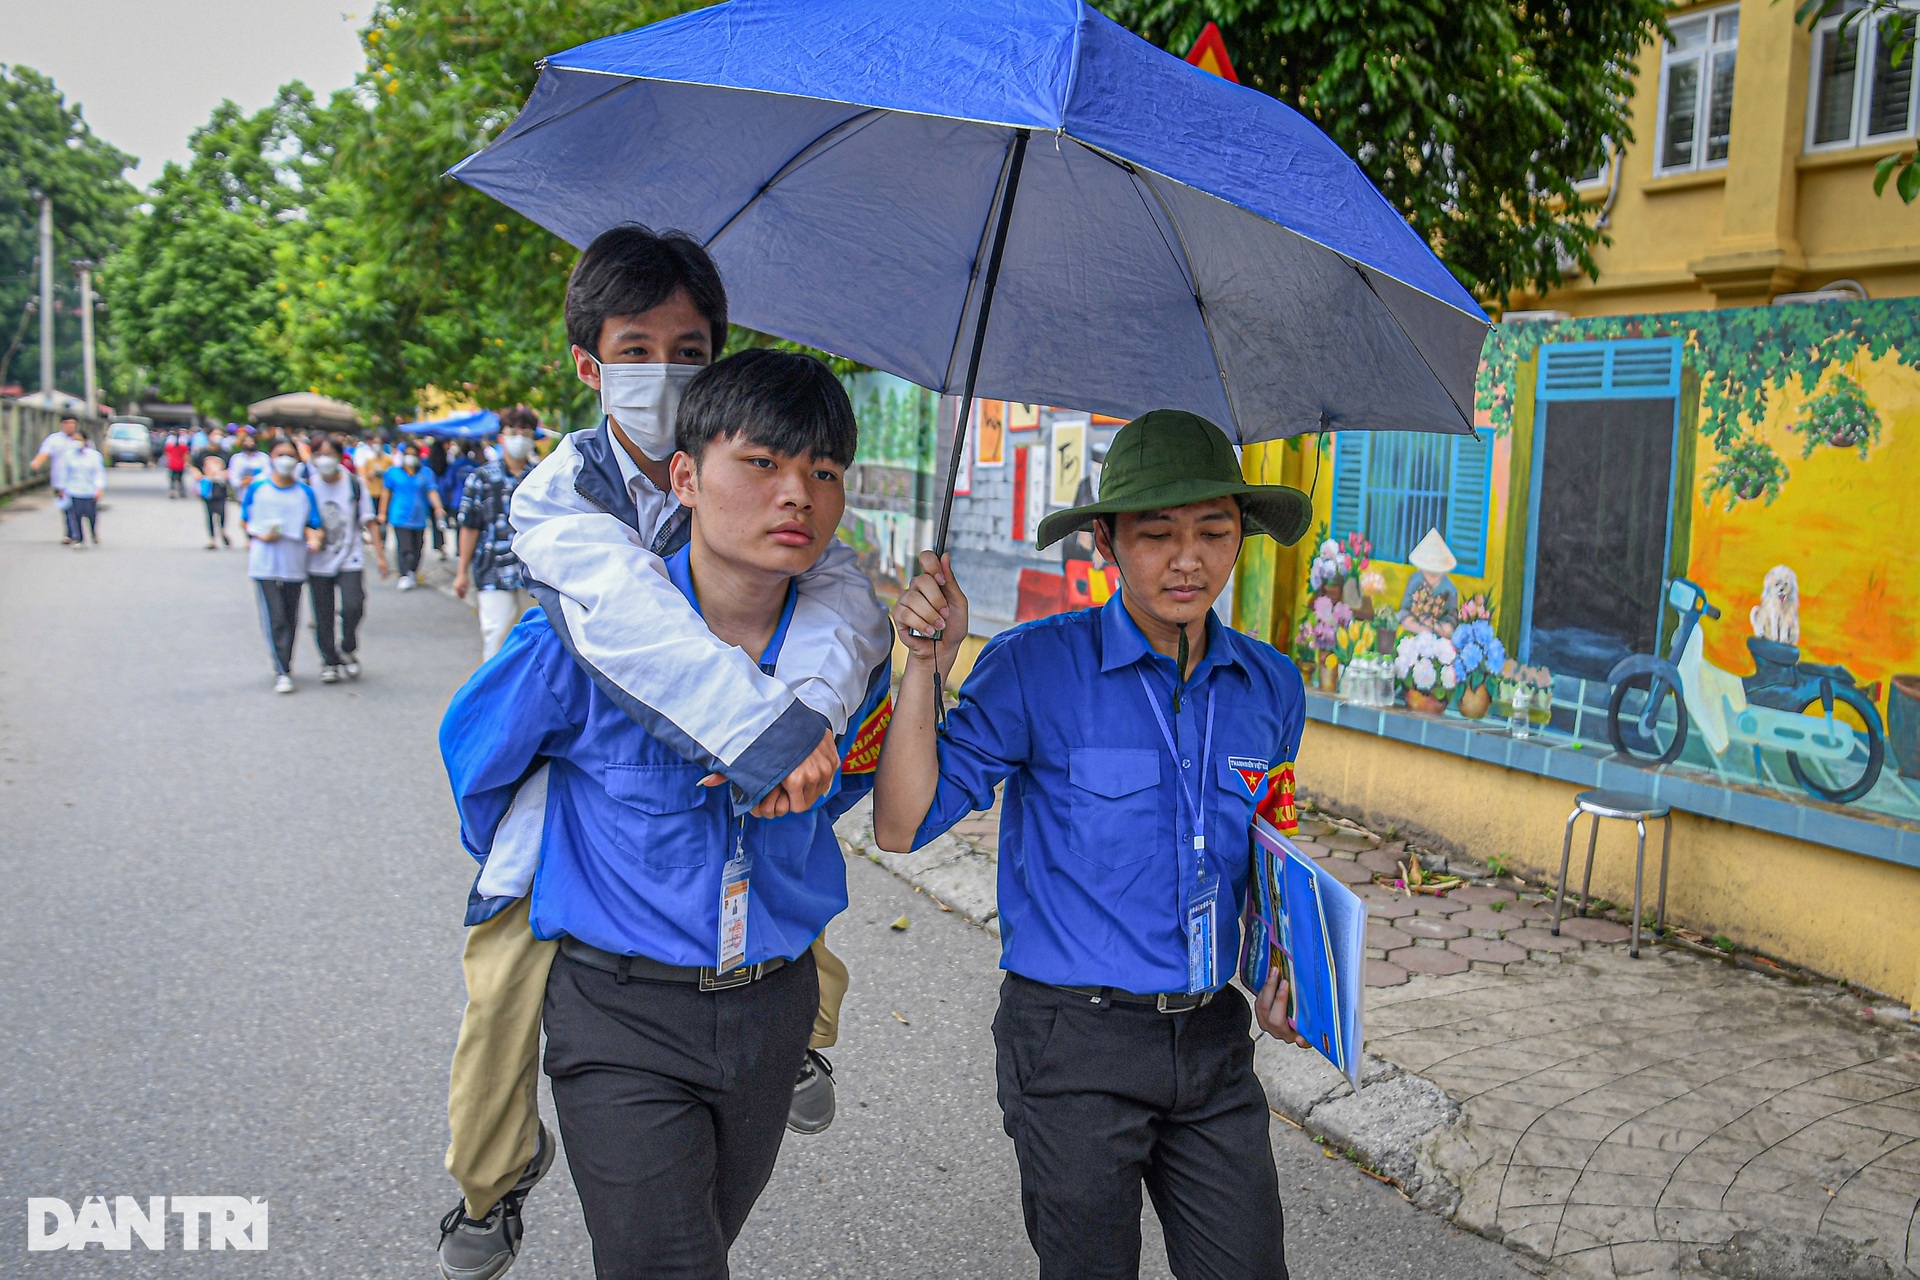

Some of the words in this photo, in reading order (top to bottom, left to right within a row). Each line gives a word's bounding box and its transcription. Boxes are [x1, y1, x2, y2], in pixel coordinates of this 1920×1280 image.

[848, 712, 891, 755] HANH
[847, 743, 881, 770] XUN
[1273, 804, 1296, 823] XU
